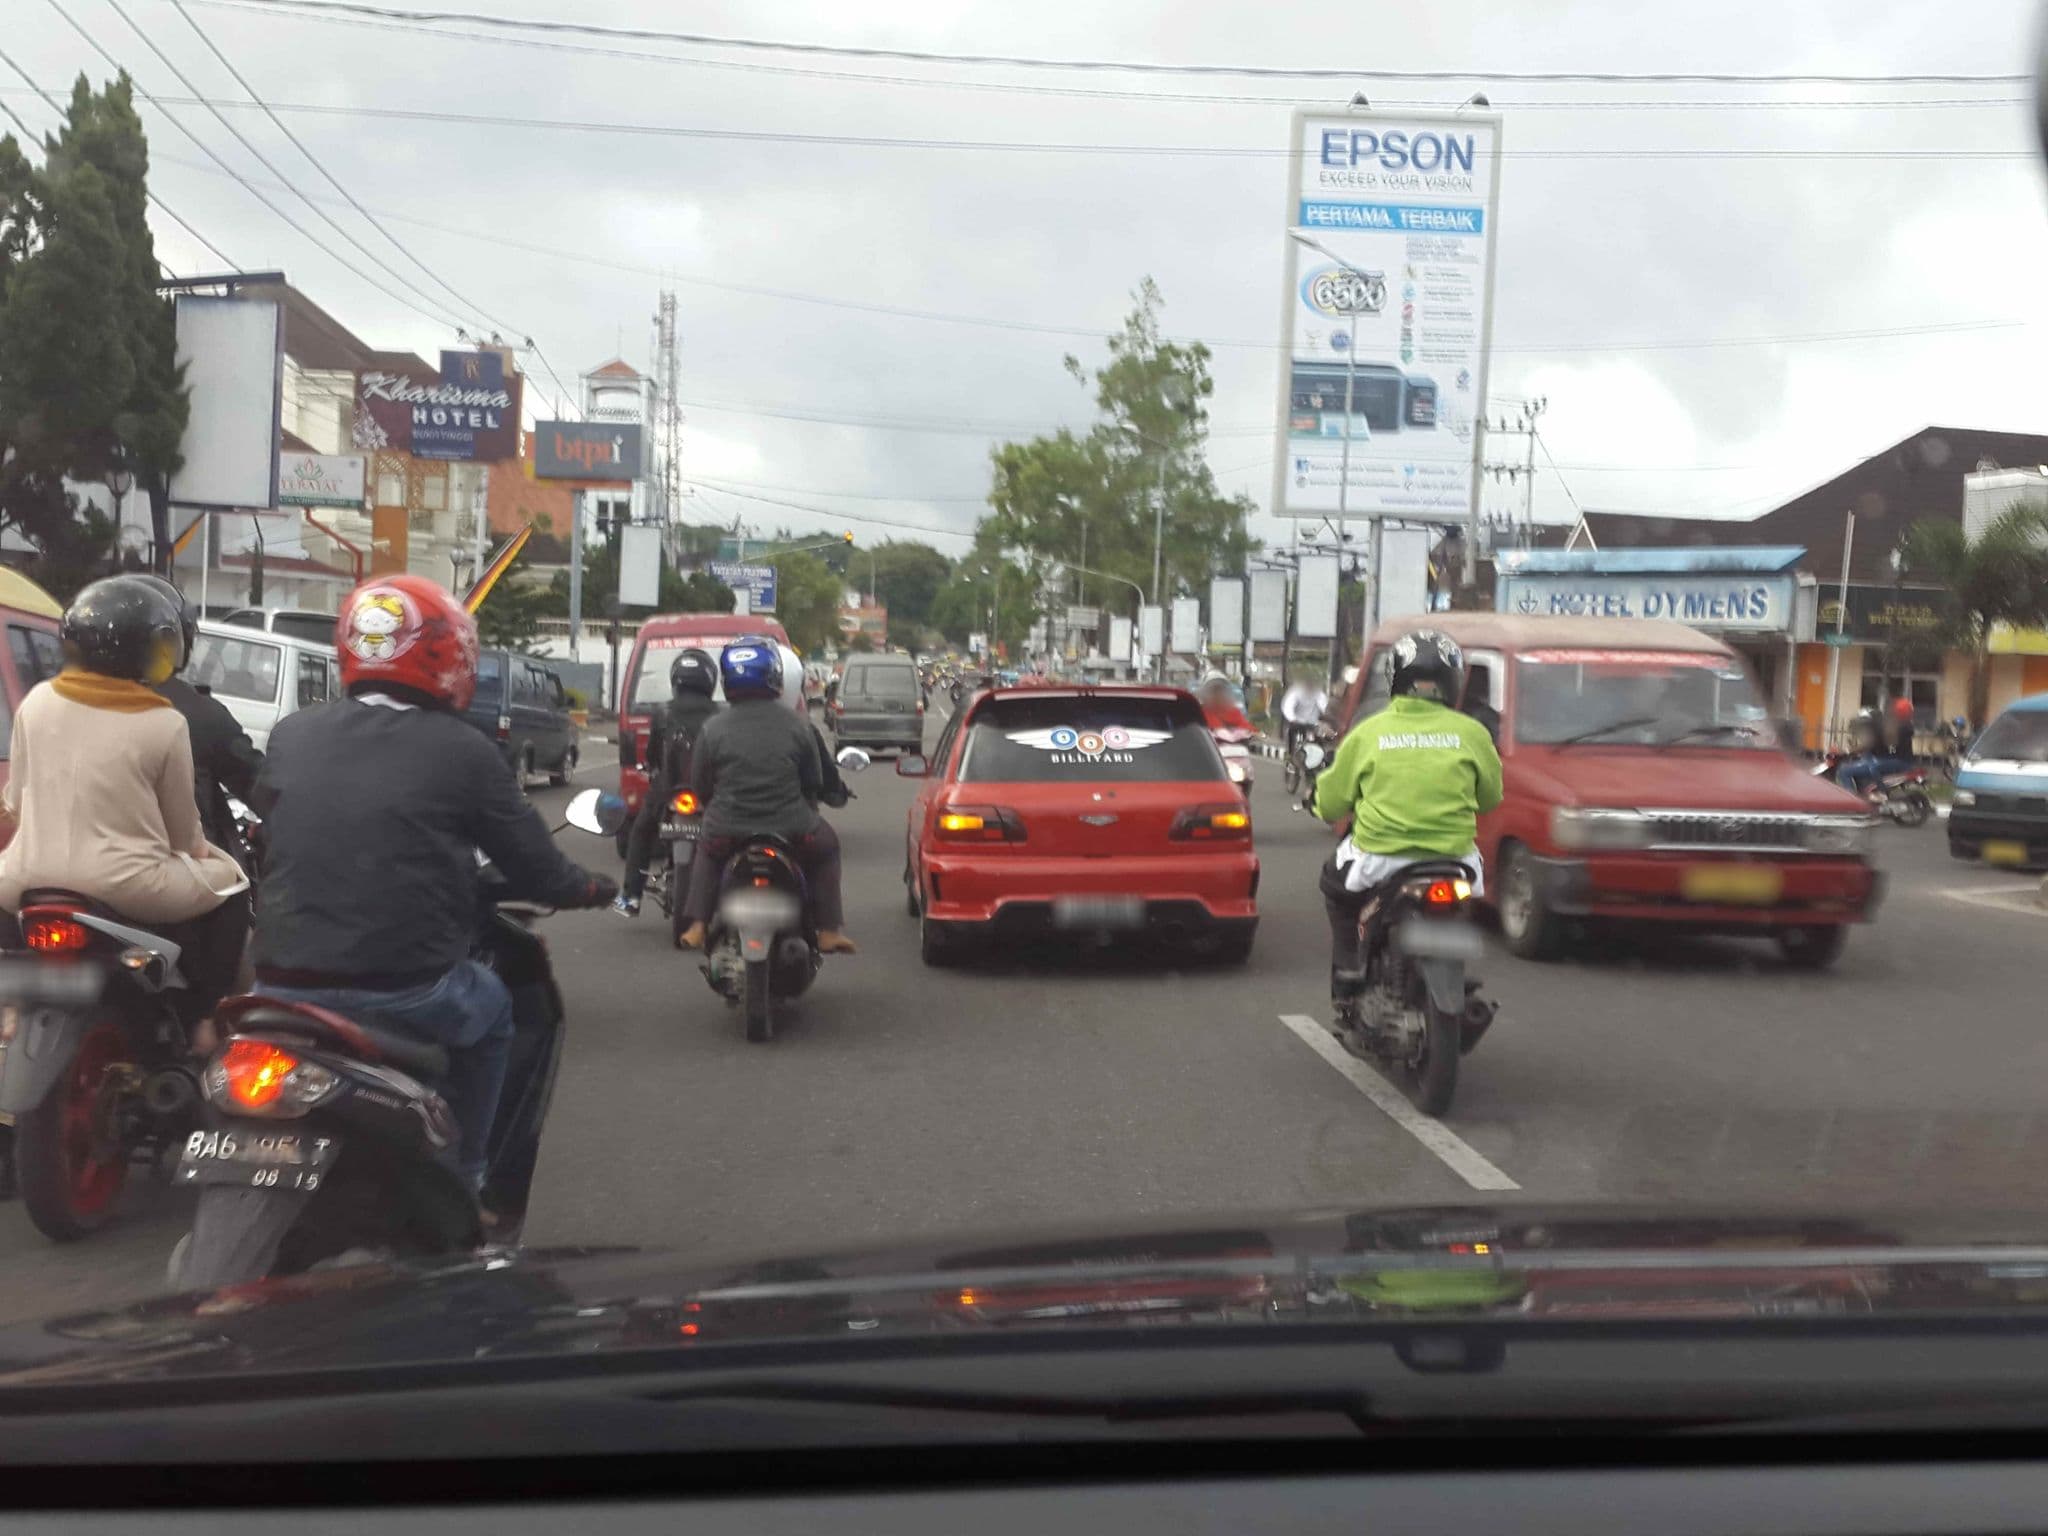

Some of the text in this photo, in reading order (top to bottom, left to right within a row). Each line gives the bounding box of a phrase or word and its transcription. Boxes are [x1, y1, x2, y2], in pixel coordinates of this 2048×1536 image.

[1321, 128, 1474, 171] EPSON
[1319, 170, 1473, 192] EXCEED YOUR VISION
[1400, 208, 1475, 231] TERBAIK
[360, 371, 512, 408] Kharisma
[412, 406, 499, 429] HOTEL
[1549, 586, 1770, 621] HOTEL DYMENS
[1050, 752, 1134, 764] BILLIYARD
